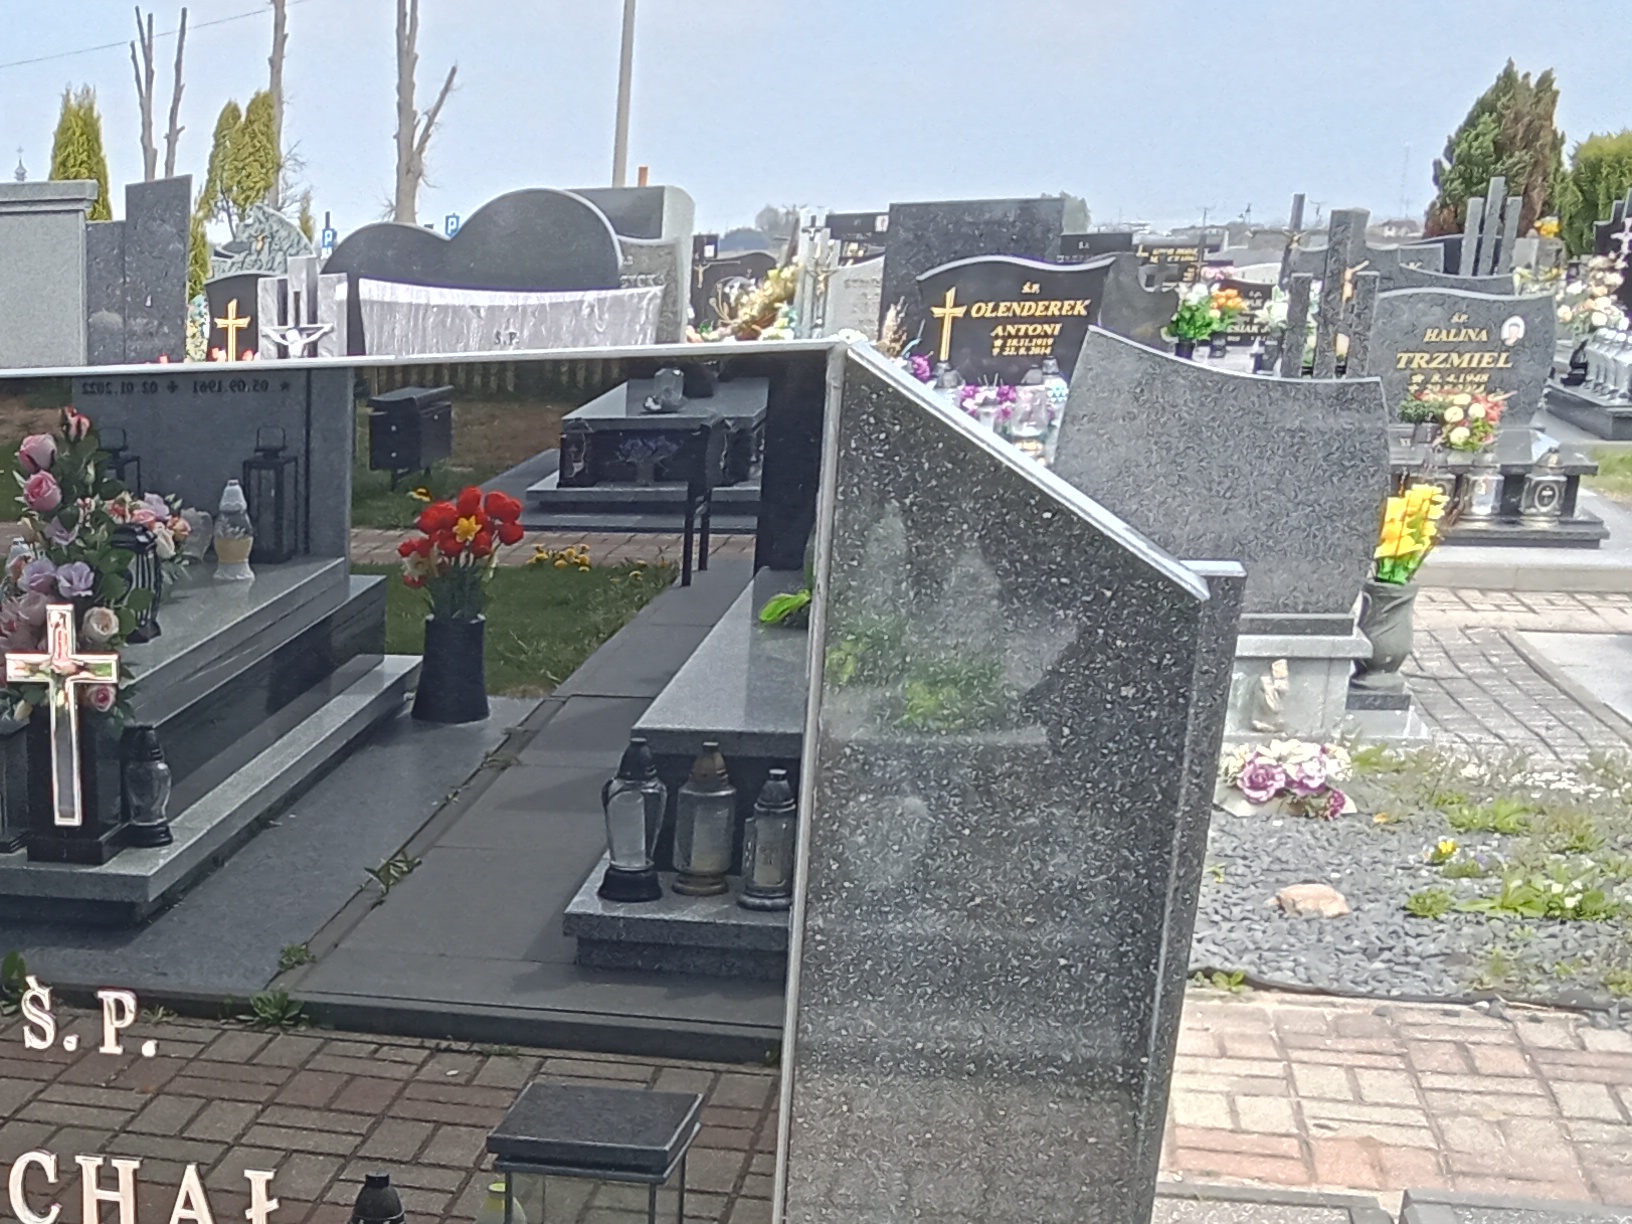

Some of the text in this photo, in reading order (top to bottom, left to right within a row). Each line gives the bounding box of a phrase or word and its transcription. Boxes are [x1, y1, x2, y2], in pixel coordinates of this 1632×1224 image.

[970, 299, 1092, 318] OLENDEREK
[990, 322, 1063, 337] ANTONI
[1422, 328, 1489, 343] HALINA
[1396, 351, 1514, 369] TRZMIEL
